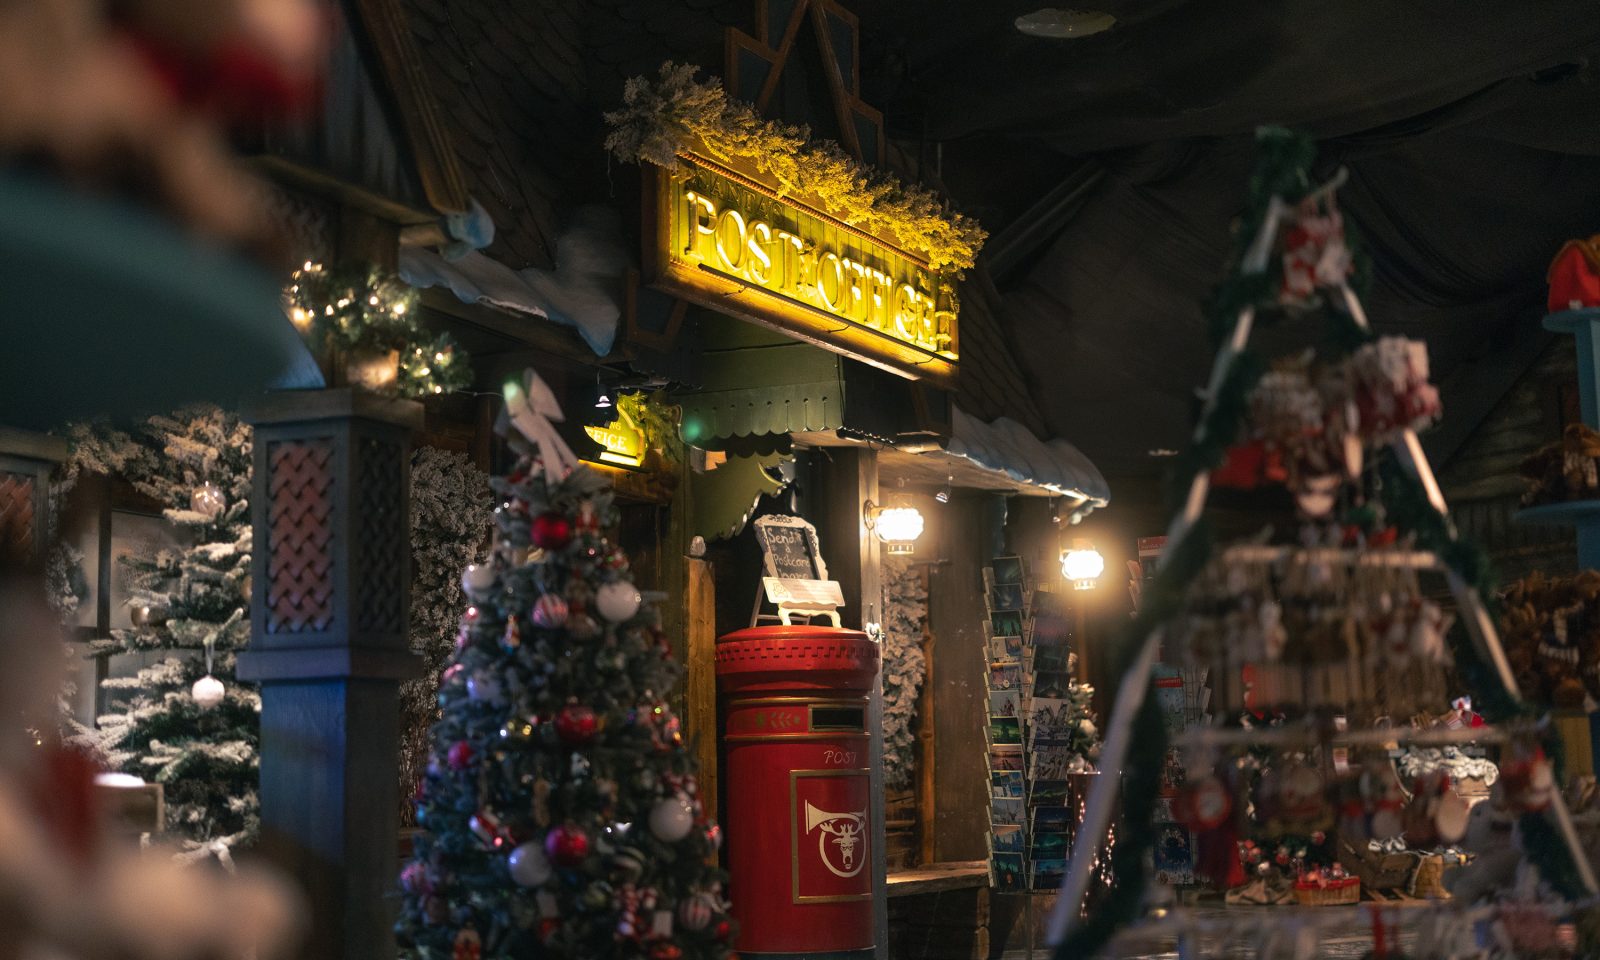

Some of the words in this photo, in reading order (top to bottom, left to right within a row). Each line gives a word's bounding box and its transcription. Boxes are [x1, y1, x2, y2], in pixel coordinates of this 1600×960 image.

[684, 190, 805, 294] POST
[816, 251, 937, 351] OFFICE
[767, 527, 795, 544] Send
[823, 750, 857, 764] POST
